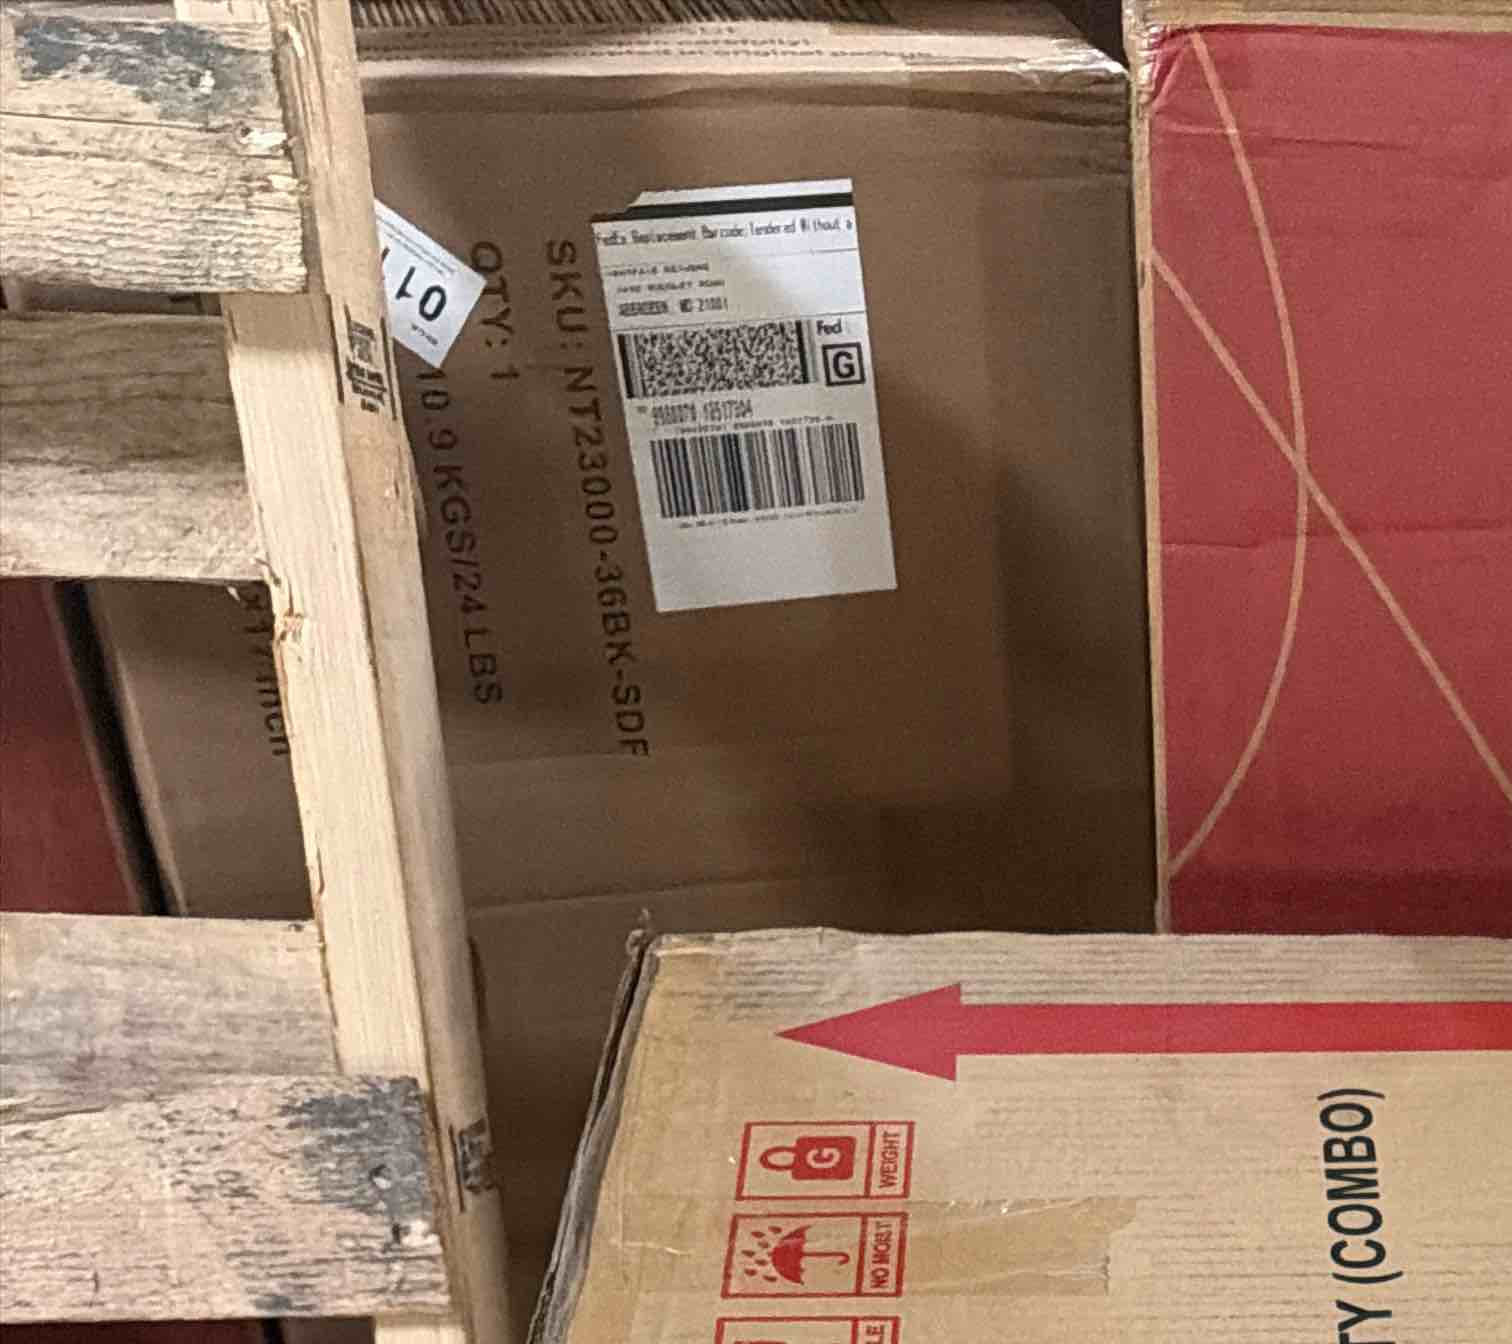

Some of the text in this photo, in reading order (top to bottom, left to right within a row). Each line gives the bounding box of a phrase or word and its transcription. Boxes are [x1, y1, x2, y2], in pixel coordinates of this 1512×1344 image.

[382, 247, 447, 322] 01
[490, 369, 520, 384] 1
[832, 351, 855, 378] G
[545, 239, 649, 757] SKU: NT23000-36BK-SDF
[433, 464, 484, 617] KGS/24
[463, 628, 504, 705] LBS
[806, 1147, 841, 1169] G
[879, 1130, 900, 1188] WEIGHT
[1316, 1088, 1404, 1284] (COMBO)
[869, 1265, 890, 1289] NO
